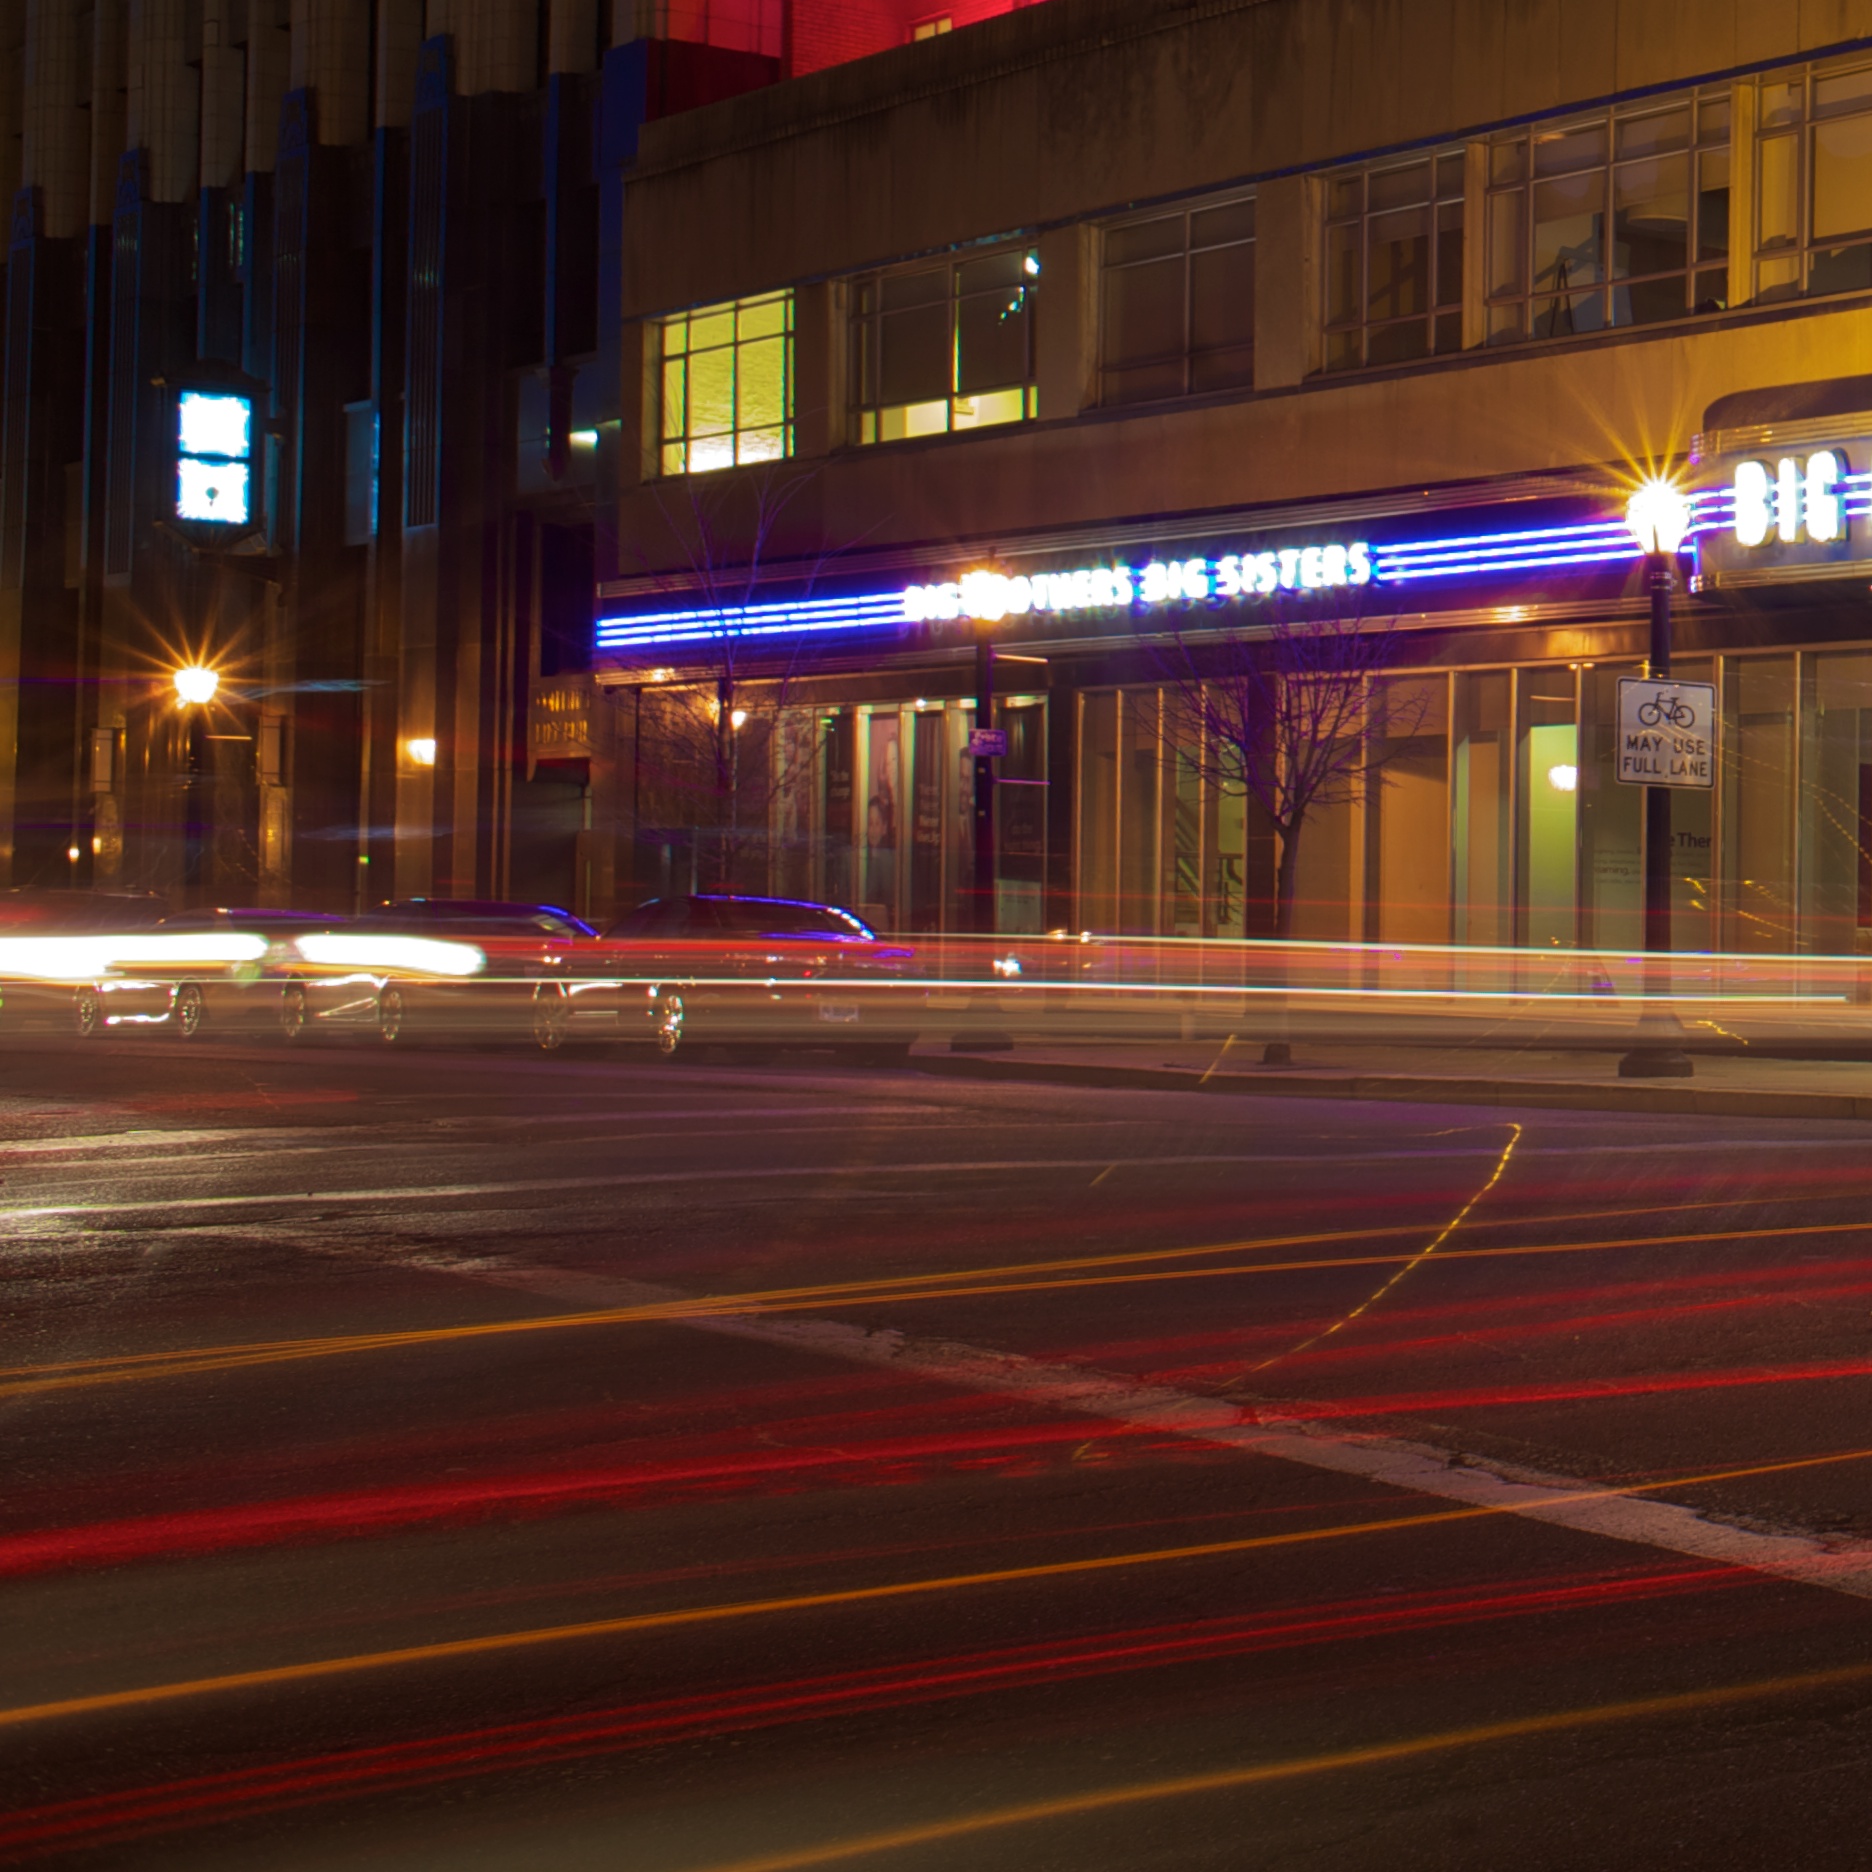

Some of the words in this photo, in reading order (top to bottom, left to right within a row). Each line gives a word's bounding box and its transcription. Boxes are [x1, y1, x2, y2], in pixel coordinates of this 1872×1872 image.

[1733, 449, 1848, 547] BIG
[961, 569, 1133, 619] OTHERS
[1136, 558, 1209, 602] BIG
[1214, 543, 1371, 595] SISTERS
[1623, 756, 1661, 774] FULL
[1670, 759, 1708, 777] LANE
[1626, 734, 1663, 752] MAY
[1673, 737, 1706, 755] USE
